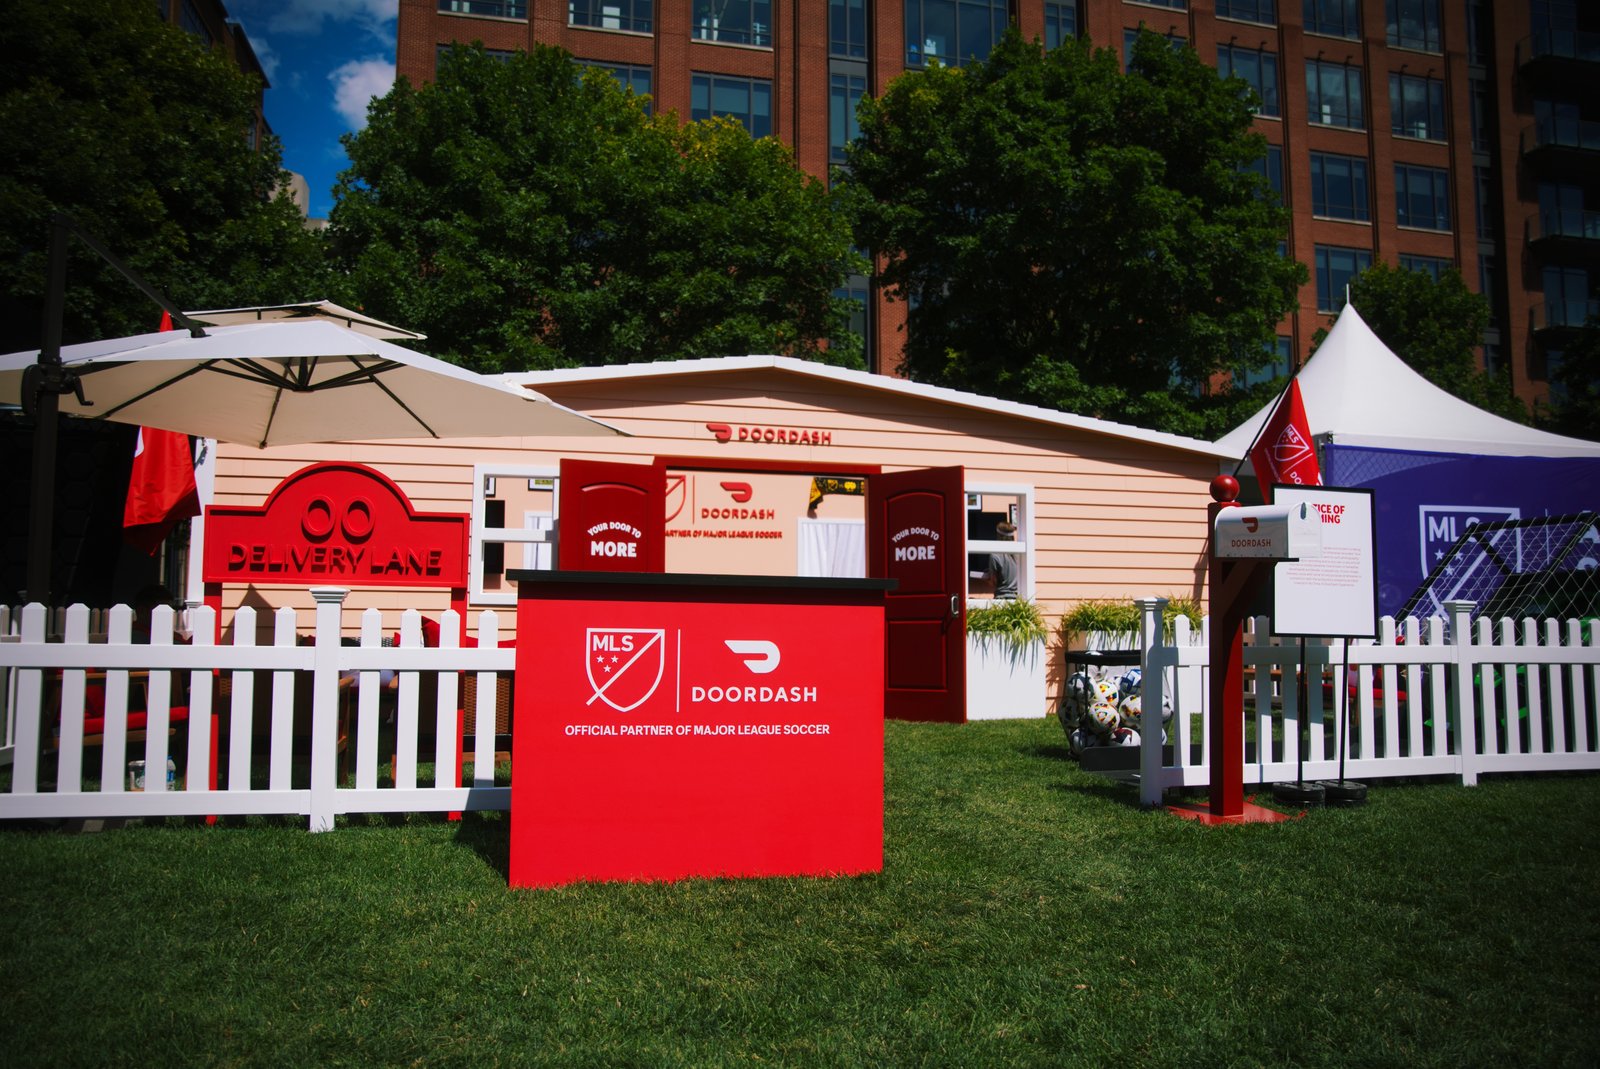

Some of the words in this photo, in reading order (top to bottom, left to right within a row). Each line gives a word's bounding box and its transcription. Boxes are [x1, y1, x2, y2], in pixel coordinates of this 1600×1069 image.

[738, 427, 832, 446] DOORDASH
[701, 508, 775, 520] DOORDASH
[1333, 504, 1345, 514] OF
[587, 522, 609, 536] YOUR
[609, 521, 632, 533] DOOR
[631, 527, 642, 539] TO
[665, 530, 692, 538] ARTNER
[693, 530, 702, 538] OF
[703, 530, 727, 538] MAJOR
[728, 531, 754, 539] LEAGUE
[755, 531, 782, 539] SOCCER
[892, 529, 910, 543] YOUR
[910, 526, 930, 536] DOOR
[930, 530, 940, 541] TO
[590, 541, 637, 558] MORE
[1231, 539, 1272, 548] DOORDASH
[228, 543, 366, 574] DELIVERY
[370, 546, 442, 576] LANE
[895, 545, 936, 562] MORE
[592, 634, 634, 652] MLS
[691, 686, 817, 702] DOORDASH
[564, 725, 618, 736] OFFICIAL
[620, 725, 674, 736] PARTNER
[675, 725, 692, 736] OF
[693, 724, 736, 735] MAJOR
[737, 724, 782, 735] LEAGUE
[783, 724, 830, 735] SOCCER
